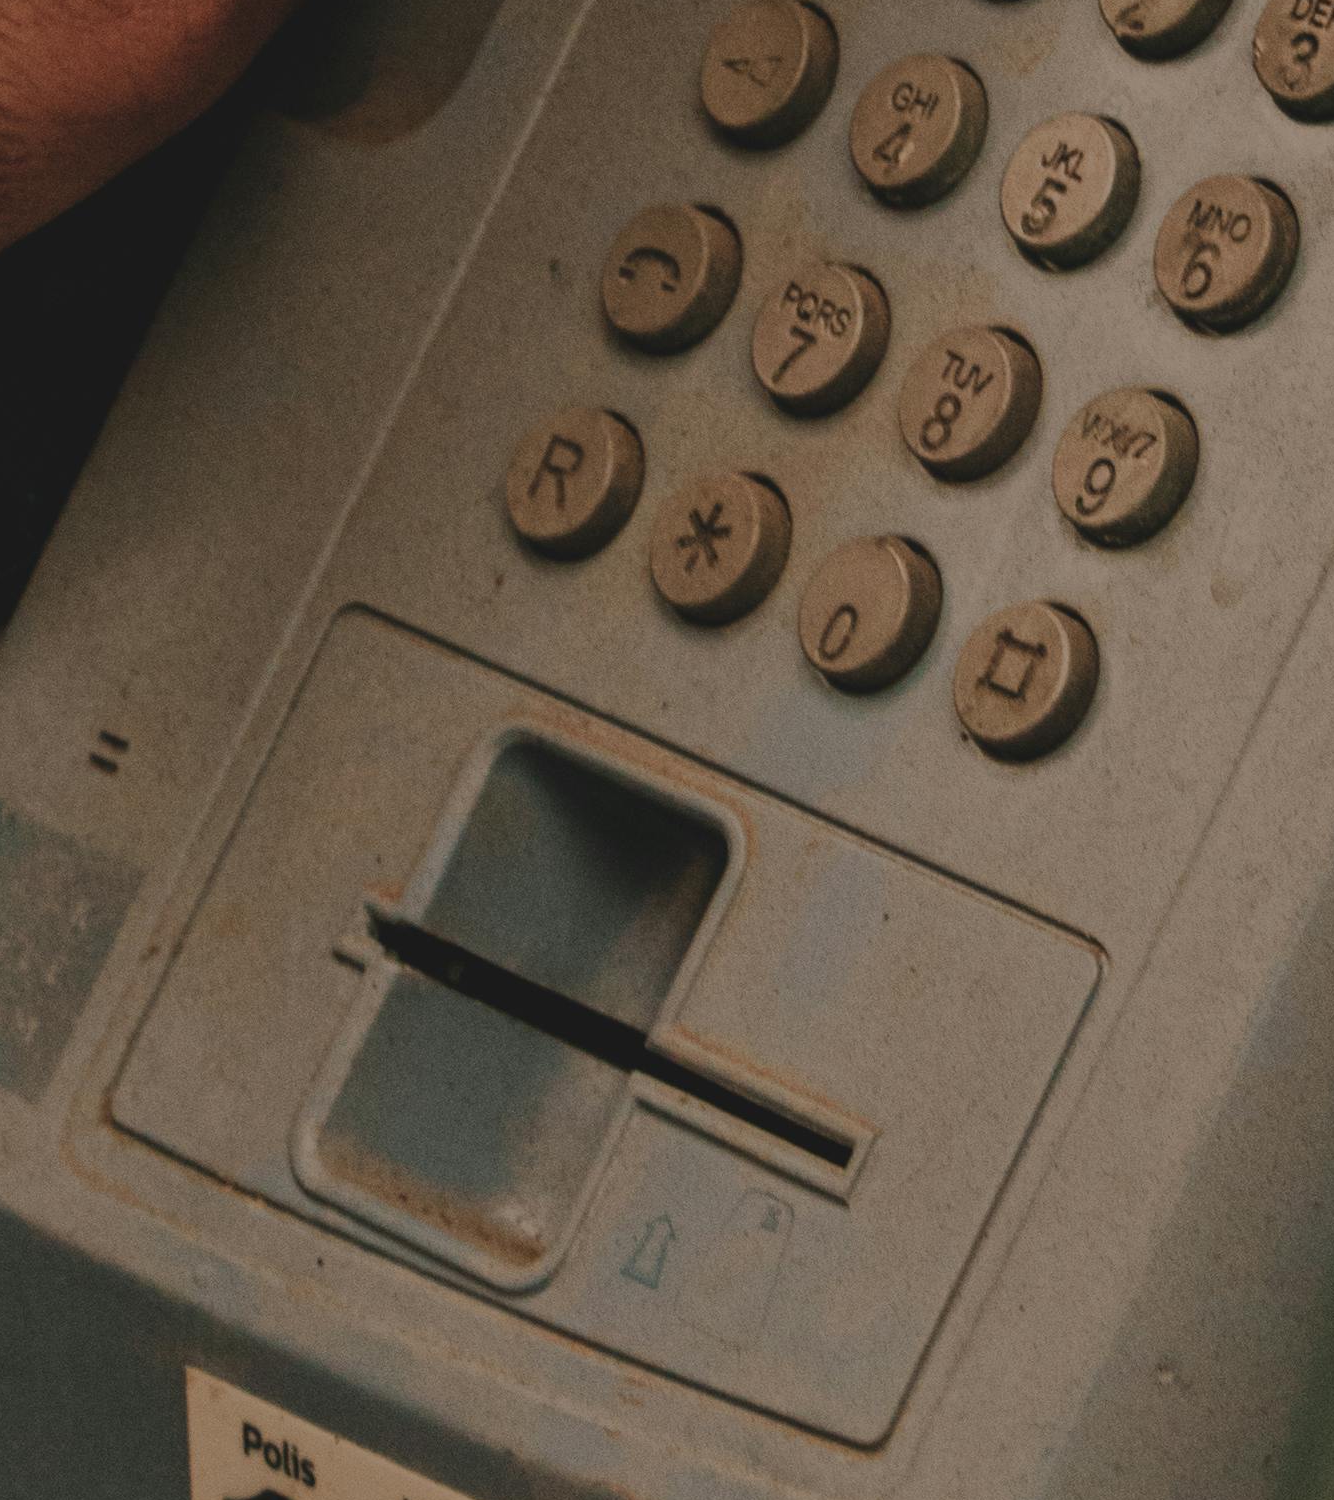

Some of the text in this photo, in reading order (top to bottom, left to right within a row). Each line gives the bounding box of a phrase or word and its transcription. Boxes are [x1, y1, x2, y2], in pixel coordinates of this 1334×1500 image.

[1274, 31, 1320, 92] 3
[891, 81, 940, 121] GHI
[871, 122, 912, 178] 4
[1041, 141, 1086, 183] JKL
[1020, 177, 1067, 236] 5
[1185, 200, 1253, 243] MNO
[1180, 242, 1220, 300] 6
[779, 281, 852, 338] PQRS
[771, 325, 817, 385] 7
[941, 349, 995, 394] TUV
[918, 395, 962, 452] 8
[527, 433, 585, 511] R
[1074, 457, 1117, 516] 9
[241, 1421, 317, 1489] Polis
